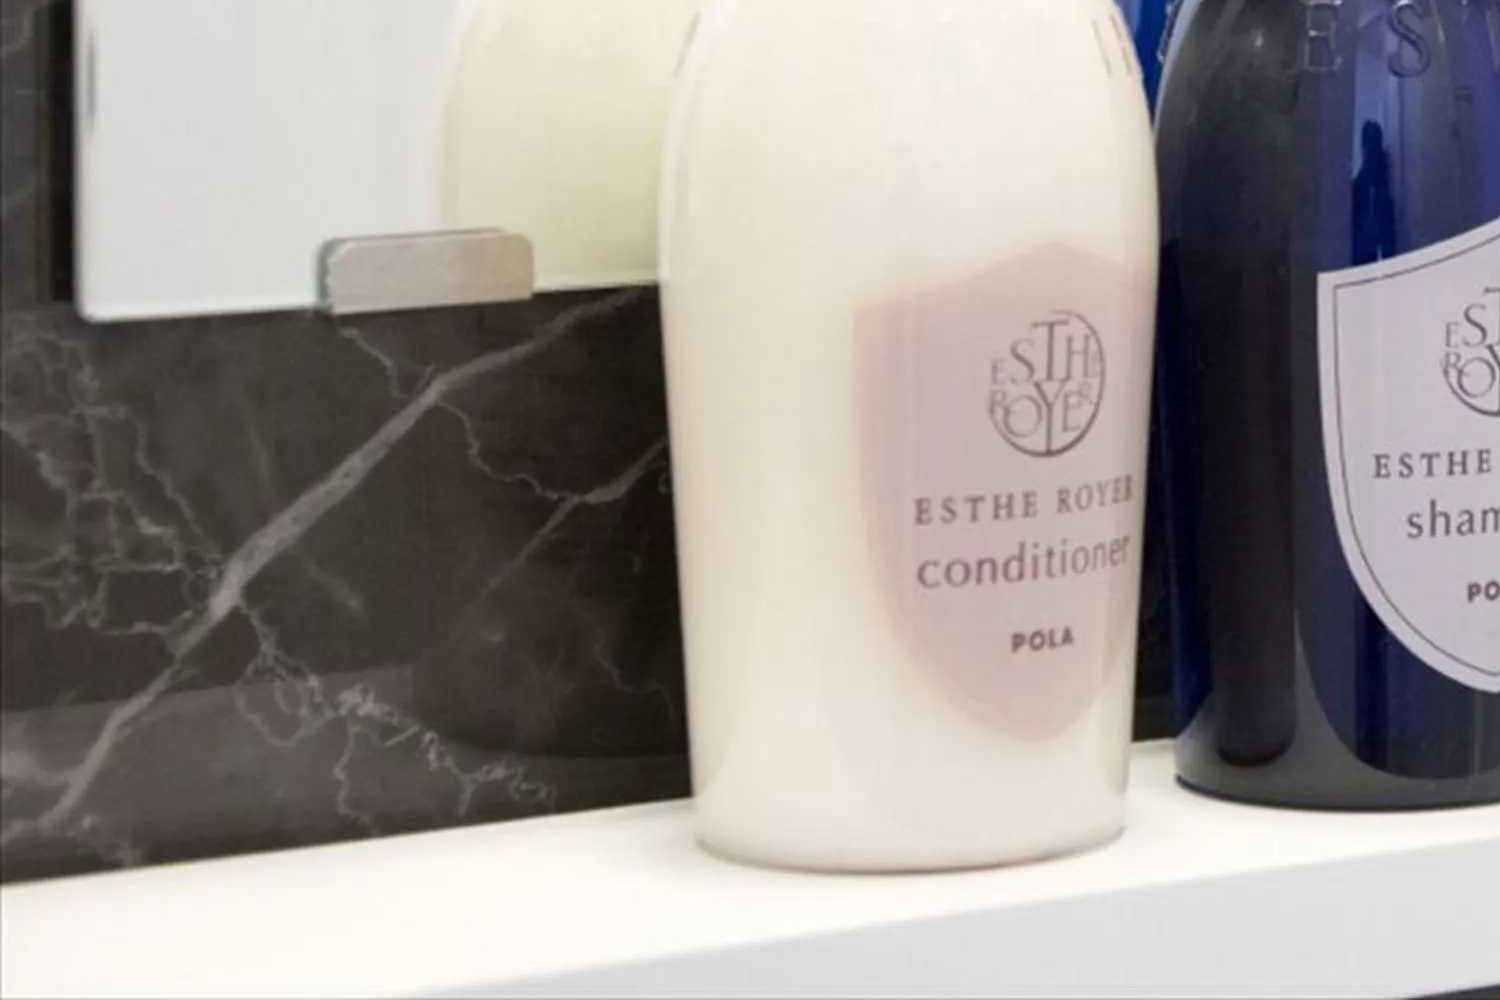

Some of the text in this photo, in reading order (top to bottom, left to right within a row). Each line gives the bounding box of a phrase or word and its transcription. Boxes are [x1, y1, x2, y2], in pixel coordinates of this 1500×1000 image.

[1373, 448, 1493, 479] ESTHE
[914, 474, 1134, 526] ESTHE ROYER
[915, 535, 1130, 590] conditioner
[1010, 626, 1075, 654] POLA
